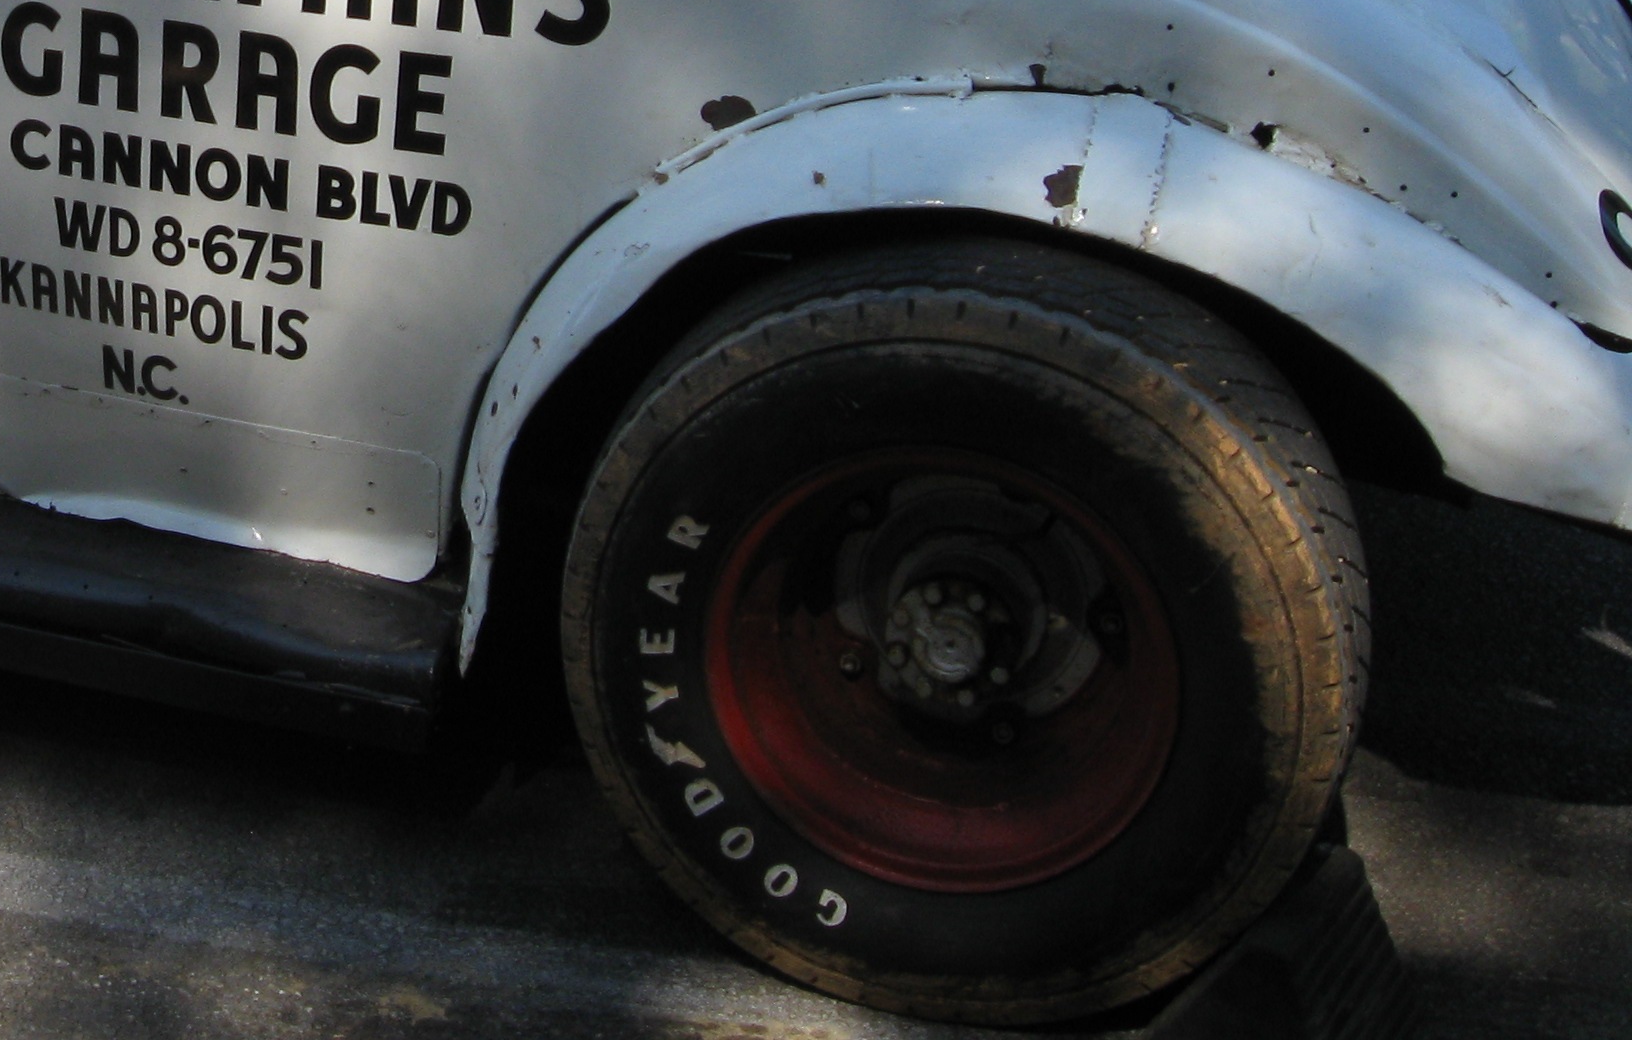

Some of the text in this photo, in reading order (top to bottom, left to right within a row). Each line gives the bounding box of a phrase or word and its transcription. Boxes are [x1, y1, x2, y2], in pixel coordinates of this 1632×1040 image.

[0, 1, 453, 156] GARAGE
[9, 118, 473, 237] CANNON BLVD
[53, 196, 324, 291] WD 8-6751
[101, 343, 189, 404] N.C.
[639, 513, 848, 927] GOODYEAR
